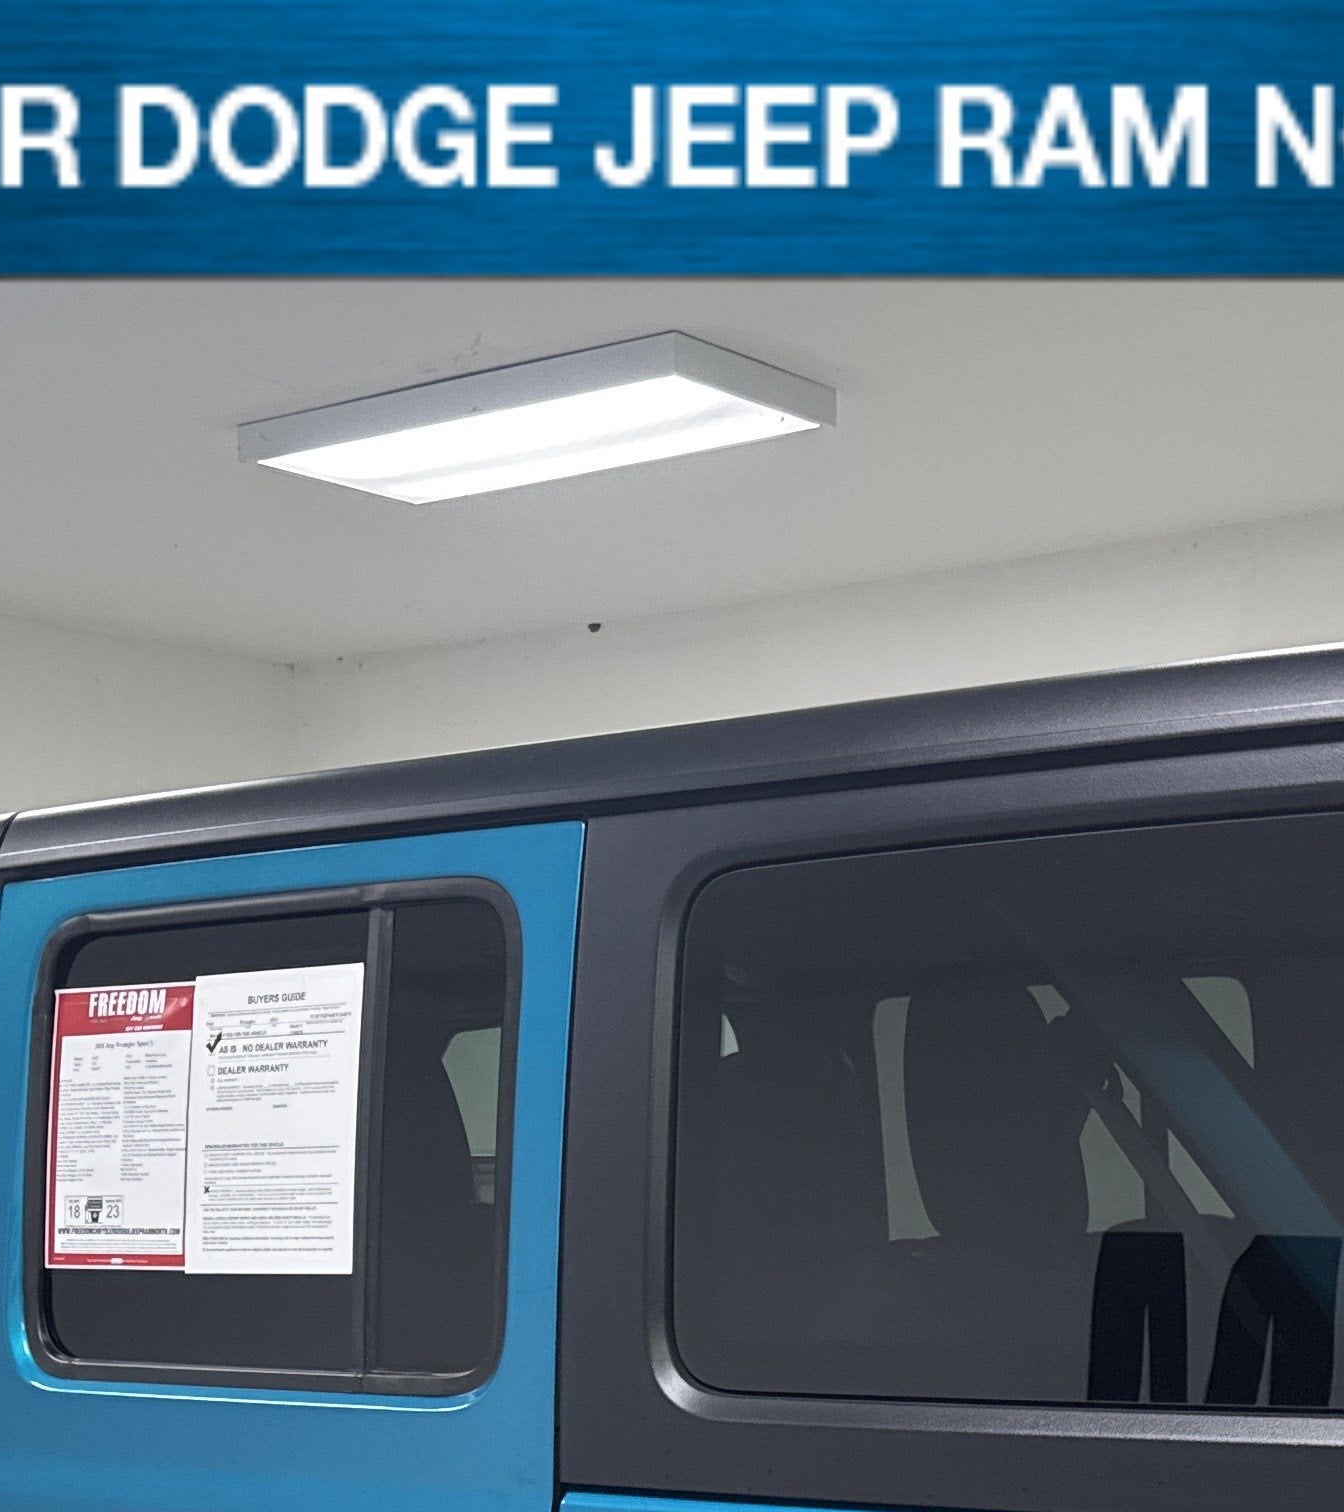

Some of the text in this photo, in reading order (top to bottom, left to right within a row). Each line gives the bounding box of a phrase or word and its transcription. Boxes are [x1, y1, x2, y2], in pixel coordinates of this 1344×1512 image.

[89, 989, 167, 1017] FREEDOM
[247, 992, 307, 1005] BUYERS GUIDE
[242, 1043, 254, 1053] NO
[255, 1042, 284, 1051] DEALER
[286, 1039, 329, 1049] WARRANTY
[218, 1063, 290, 1075] DEALER WARRANTY
[68, 1204, 81, 1219] 18
[106, 1204, 120, 1219] 23
